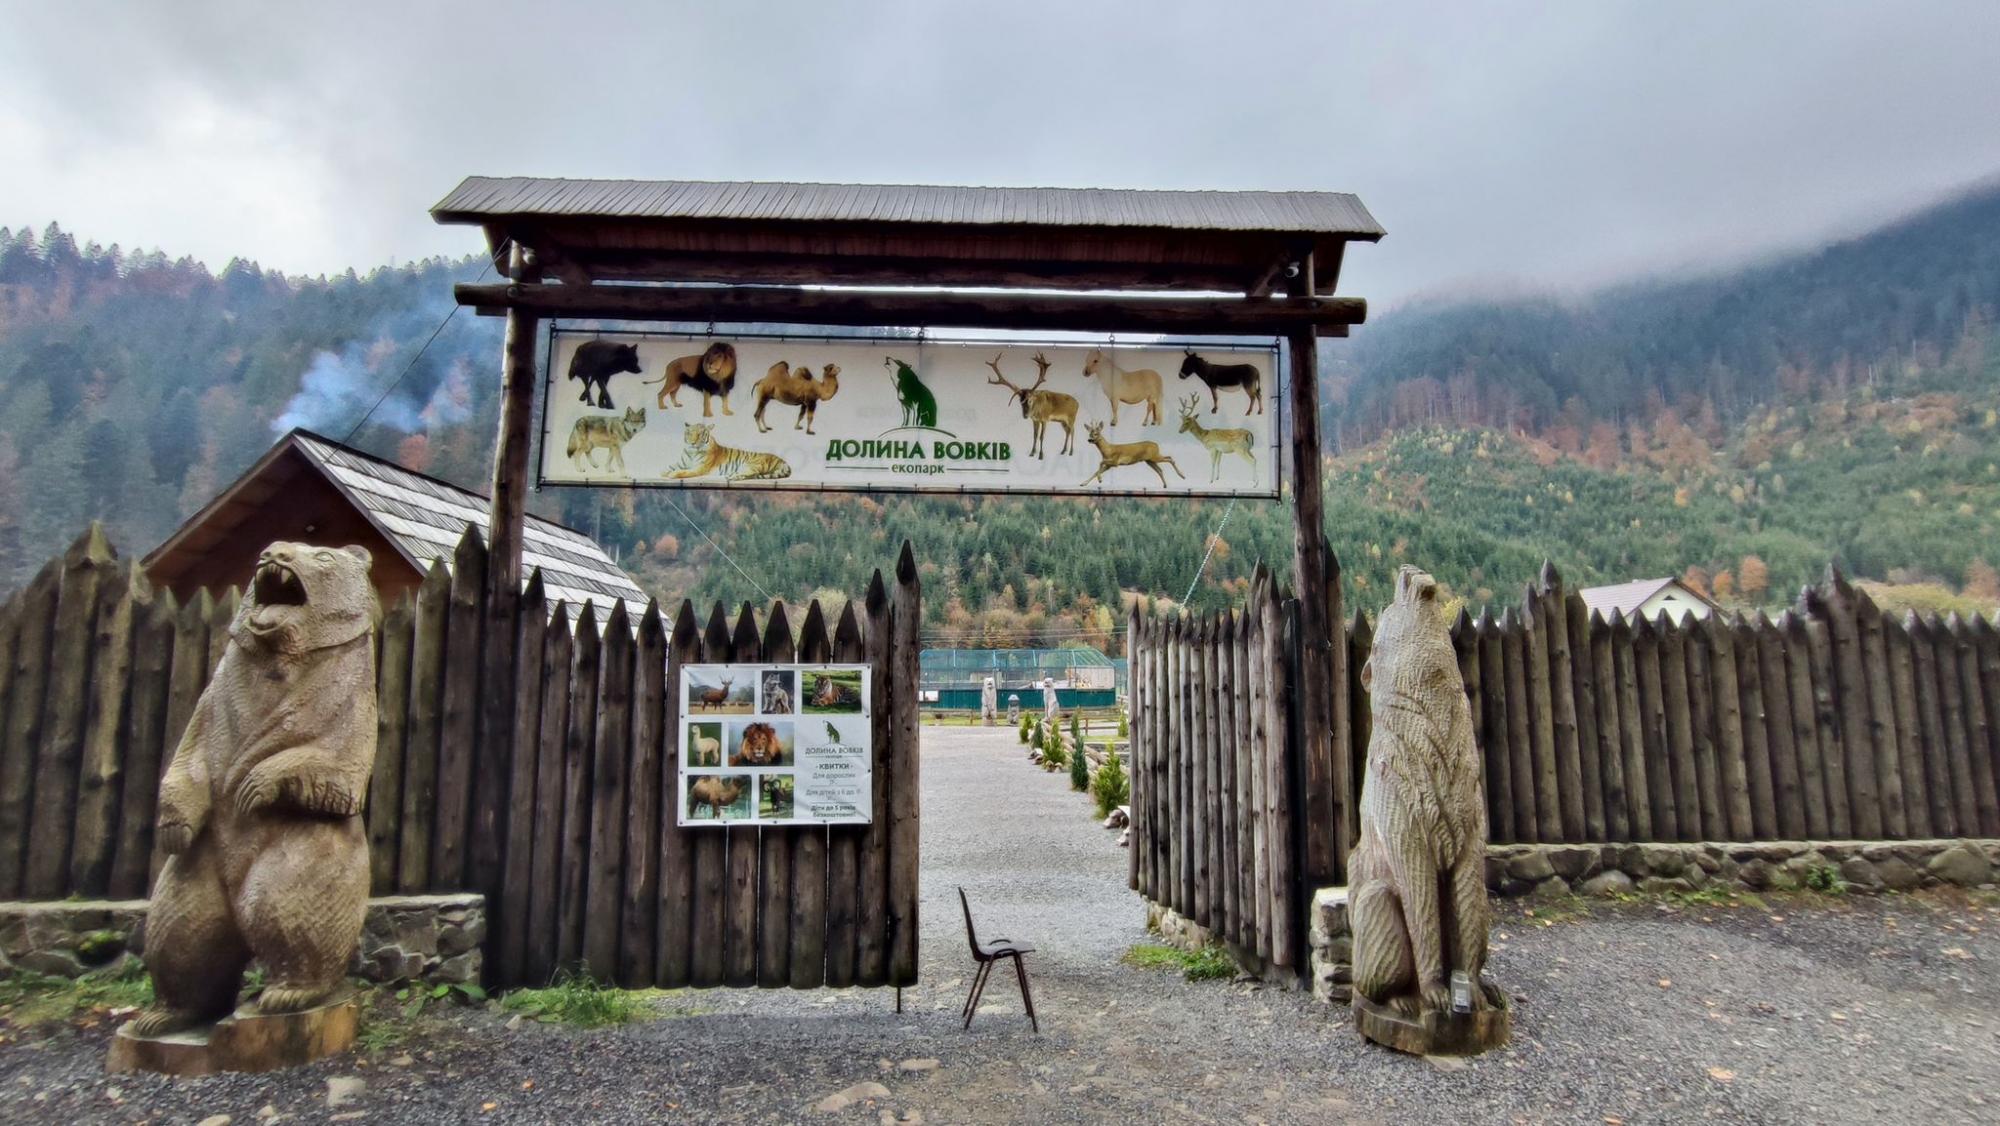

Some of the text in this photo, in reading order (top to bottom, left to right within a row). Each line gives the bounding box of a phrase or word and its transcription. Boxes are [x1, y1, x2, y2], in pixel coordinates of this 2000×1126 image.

[826, 439, 926, 462] ДОЛИНА
[933, 441, 1012, 461] ВОВКІВ
[891, 463, 945, 476] екопарк
